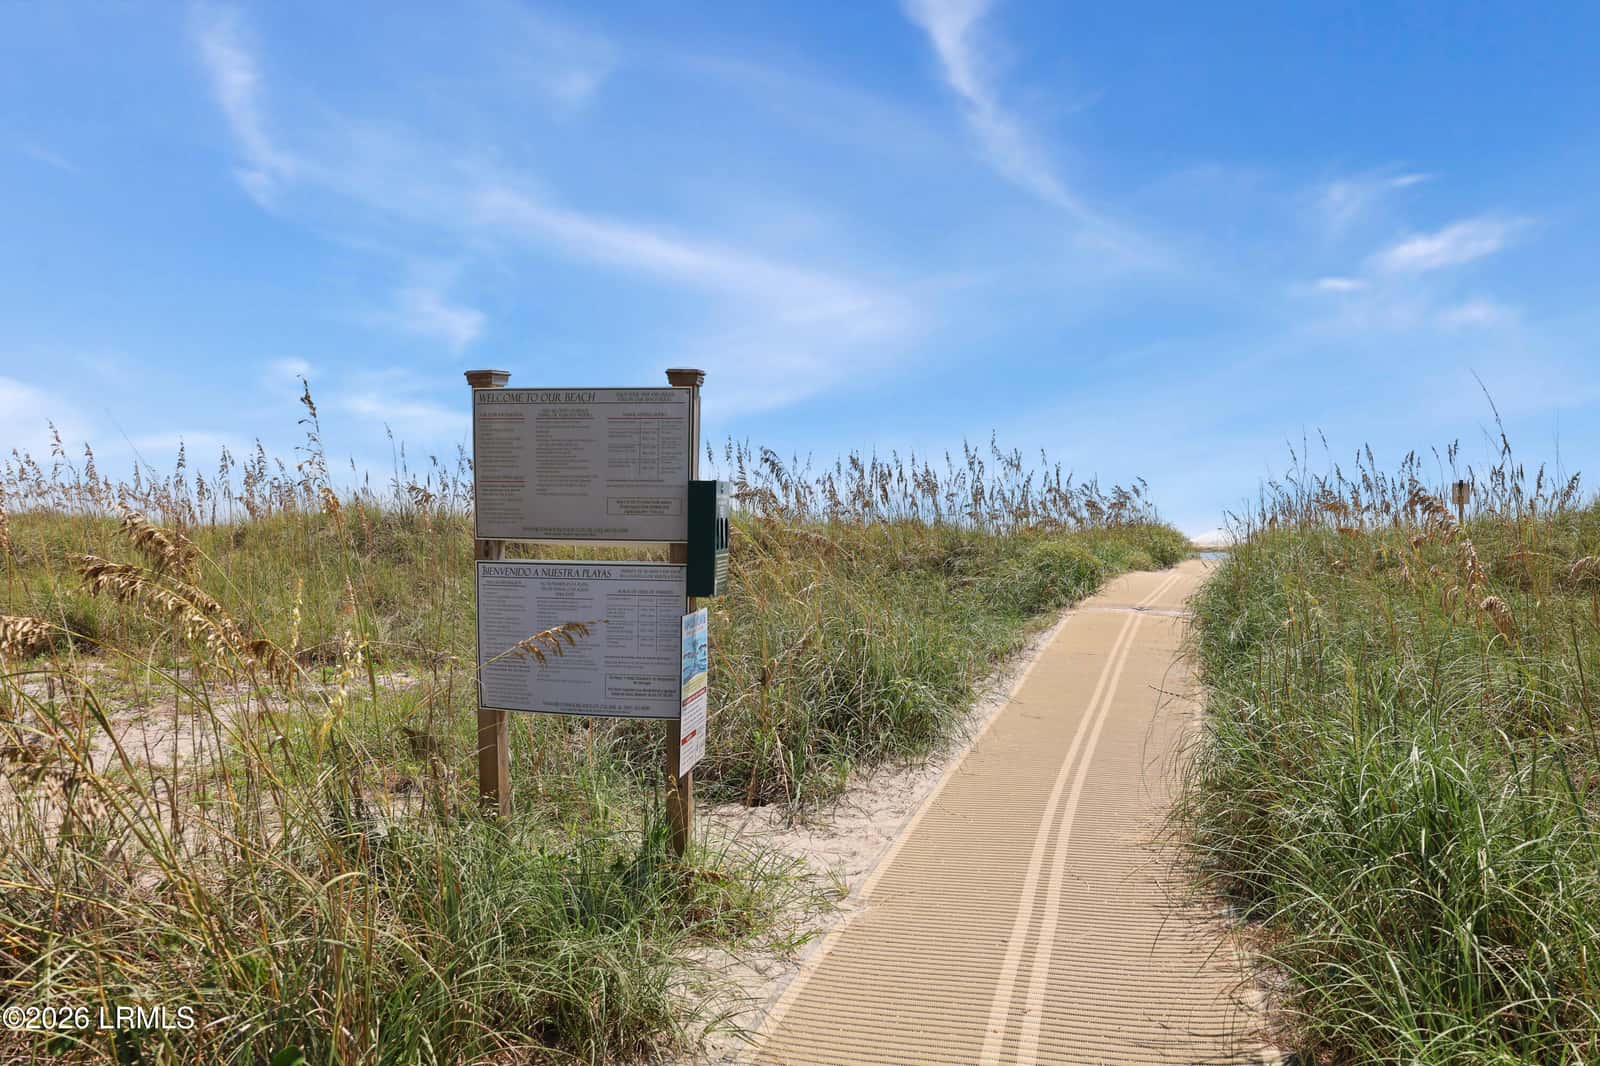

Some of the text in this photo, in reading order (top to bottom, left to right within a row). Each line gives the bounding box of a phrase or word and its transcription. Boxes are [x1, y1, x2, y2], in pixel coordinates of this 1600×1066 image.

[479, 391, 596, 402] WELCOME TO OUR BEACH
[482, 566, 531, 577] BIENVENIDO
[532, 568, 539, 577] A
[541, 568, 580, 578] NUESTRA
[582, 568, 612, 578] PLAYAS
